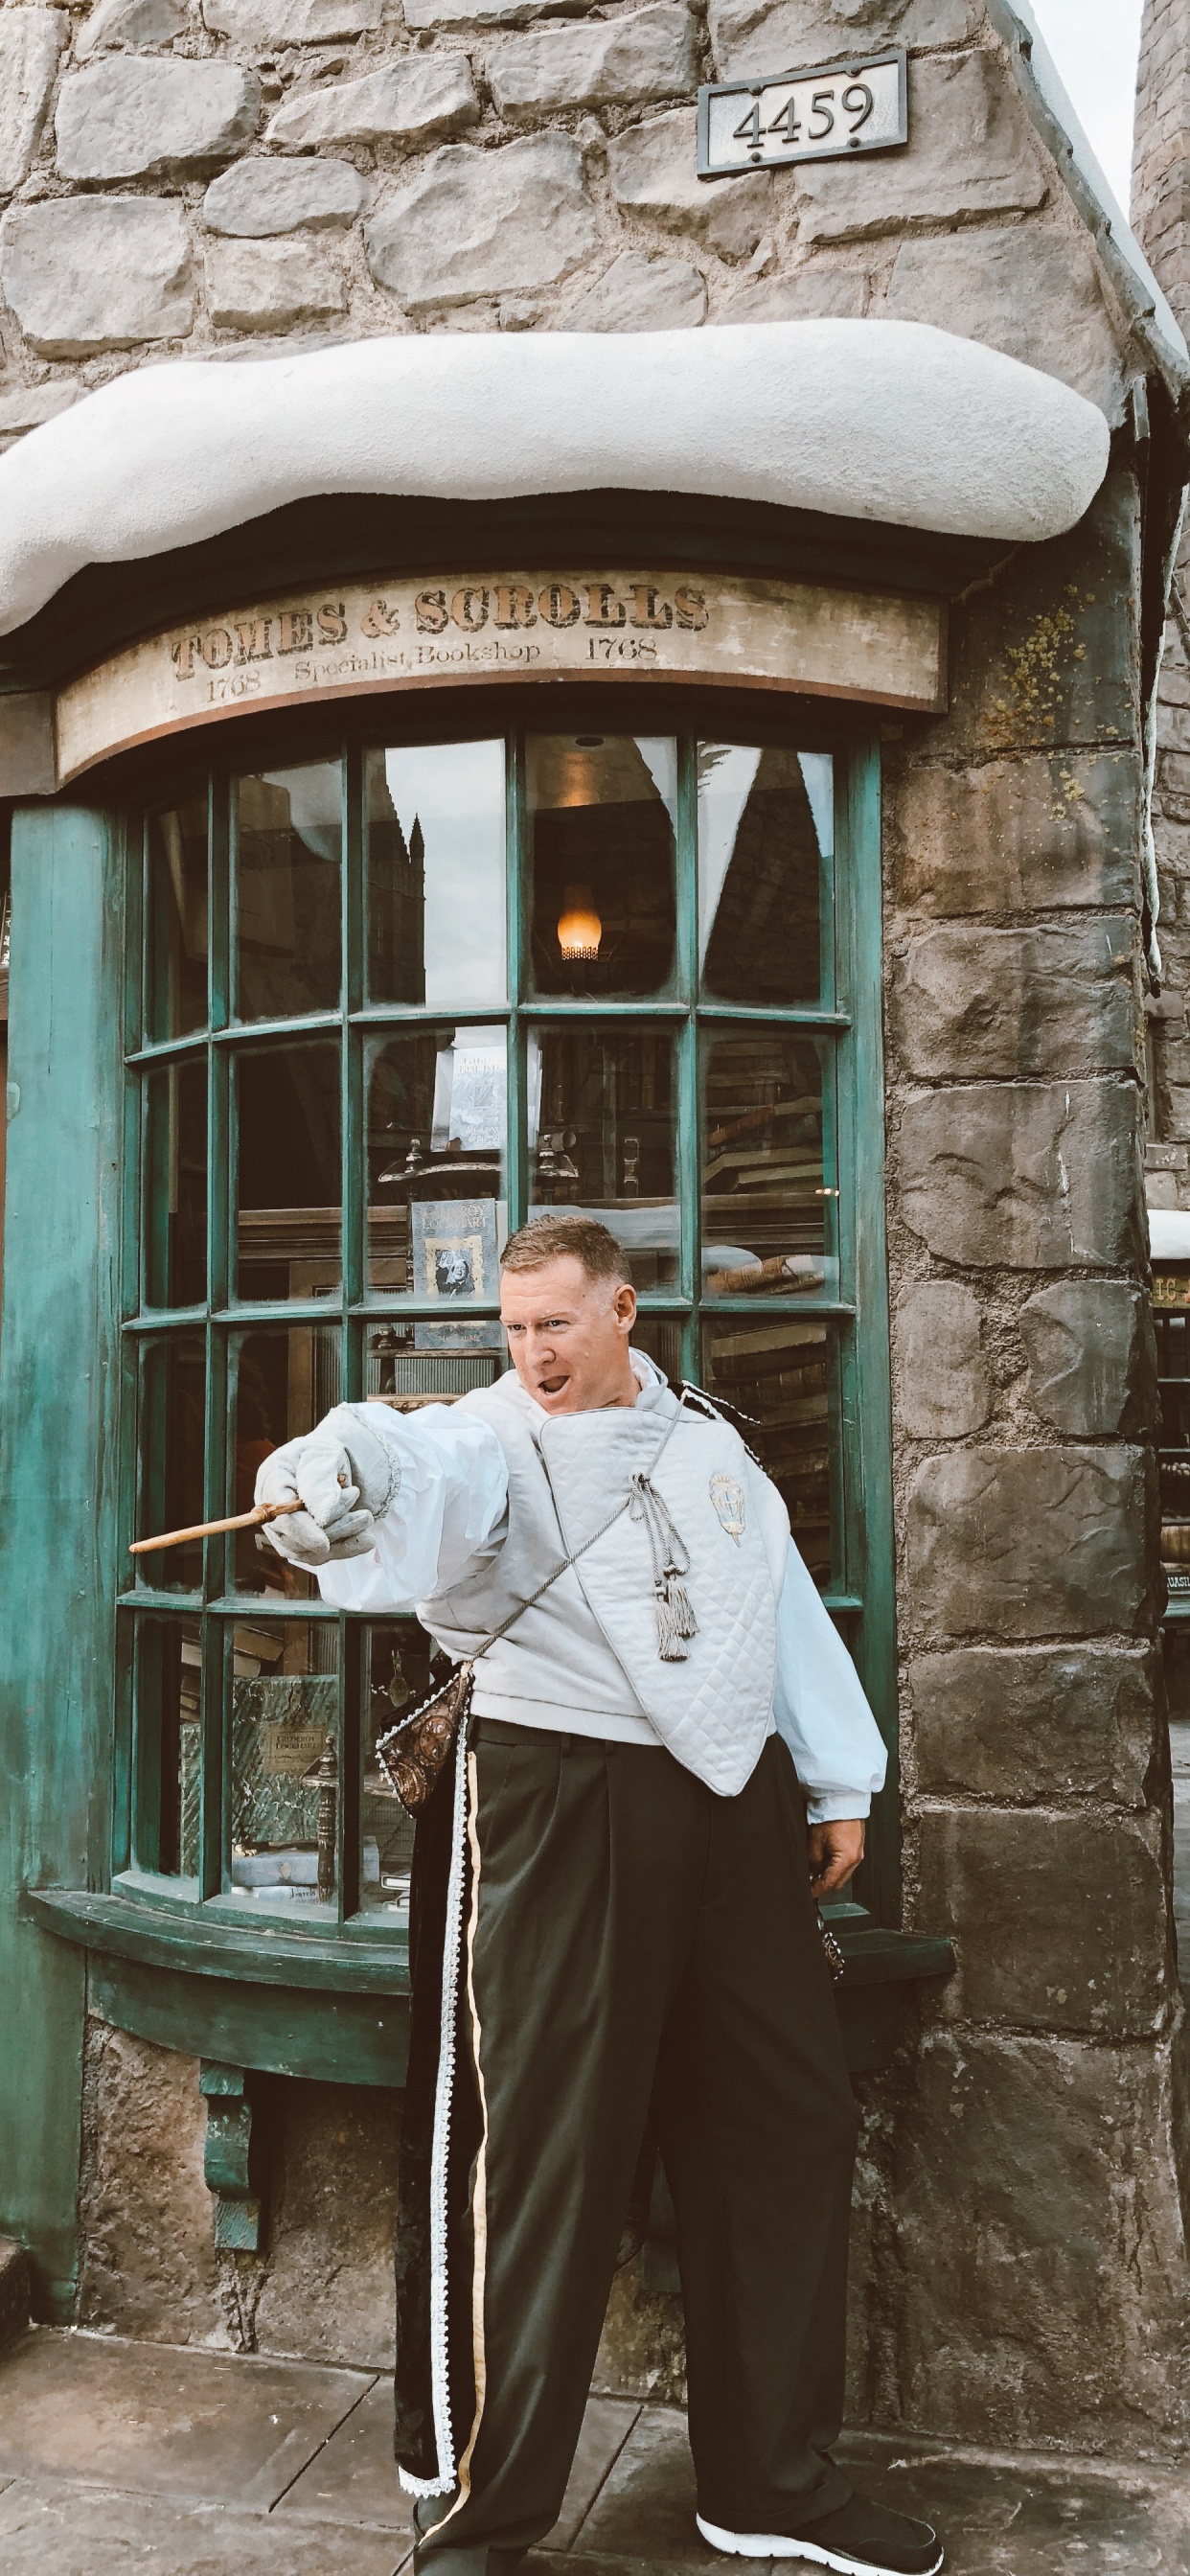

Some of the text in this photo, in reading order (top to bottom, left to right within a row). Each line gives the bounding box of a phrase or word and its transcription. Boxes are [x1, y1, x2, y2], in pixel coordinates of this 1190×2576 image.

[732, 82, 875, 149] 4459
[172, 583, 710, 681] TOMES & SCROLLS
[207, 637, 658, 702] 1768 Specialist Bookshop 1768
